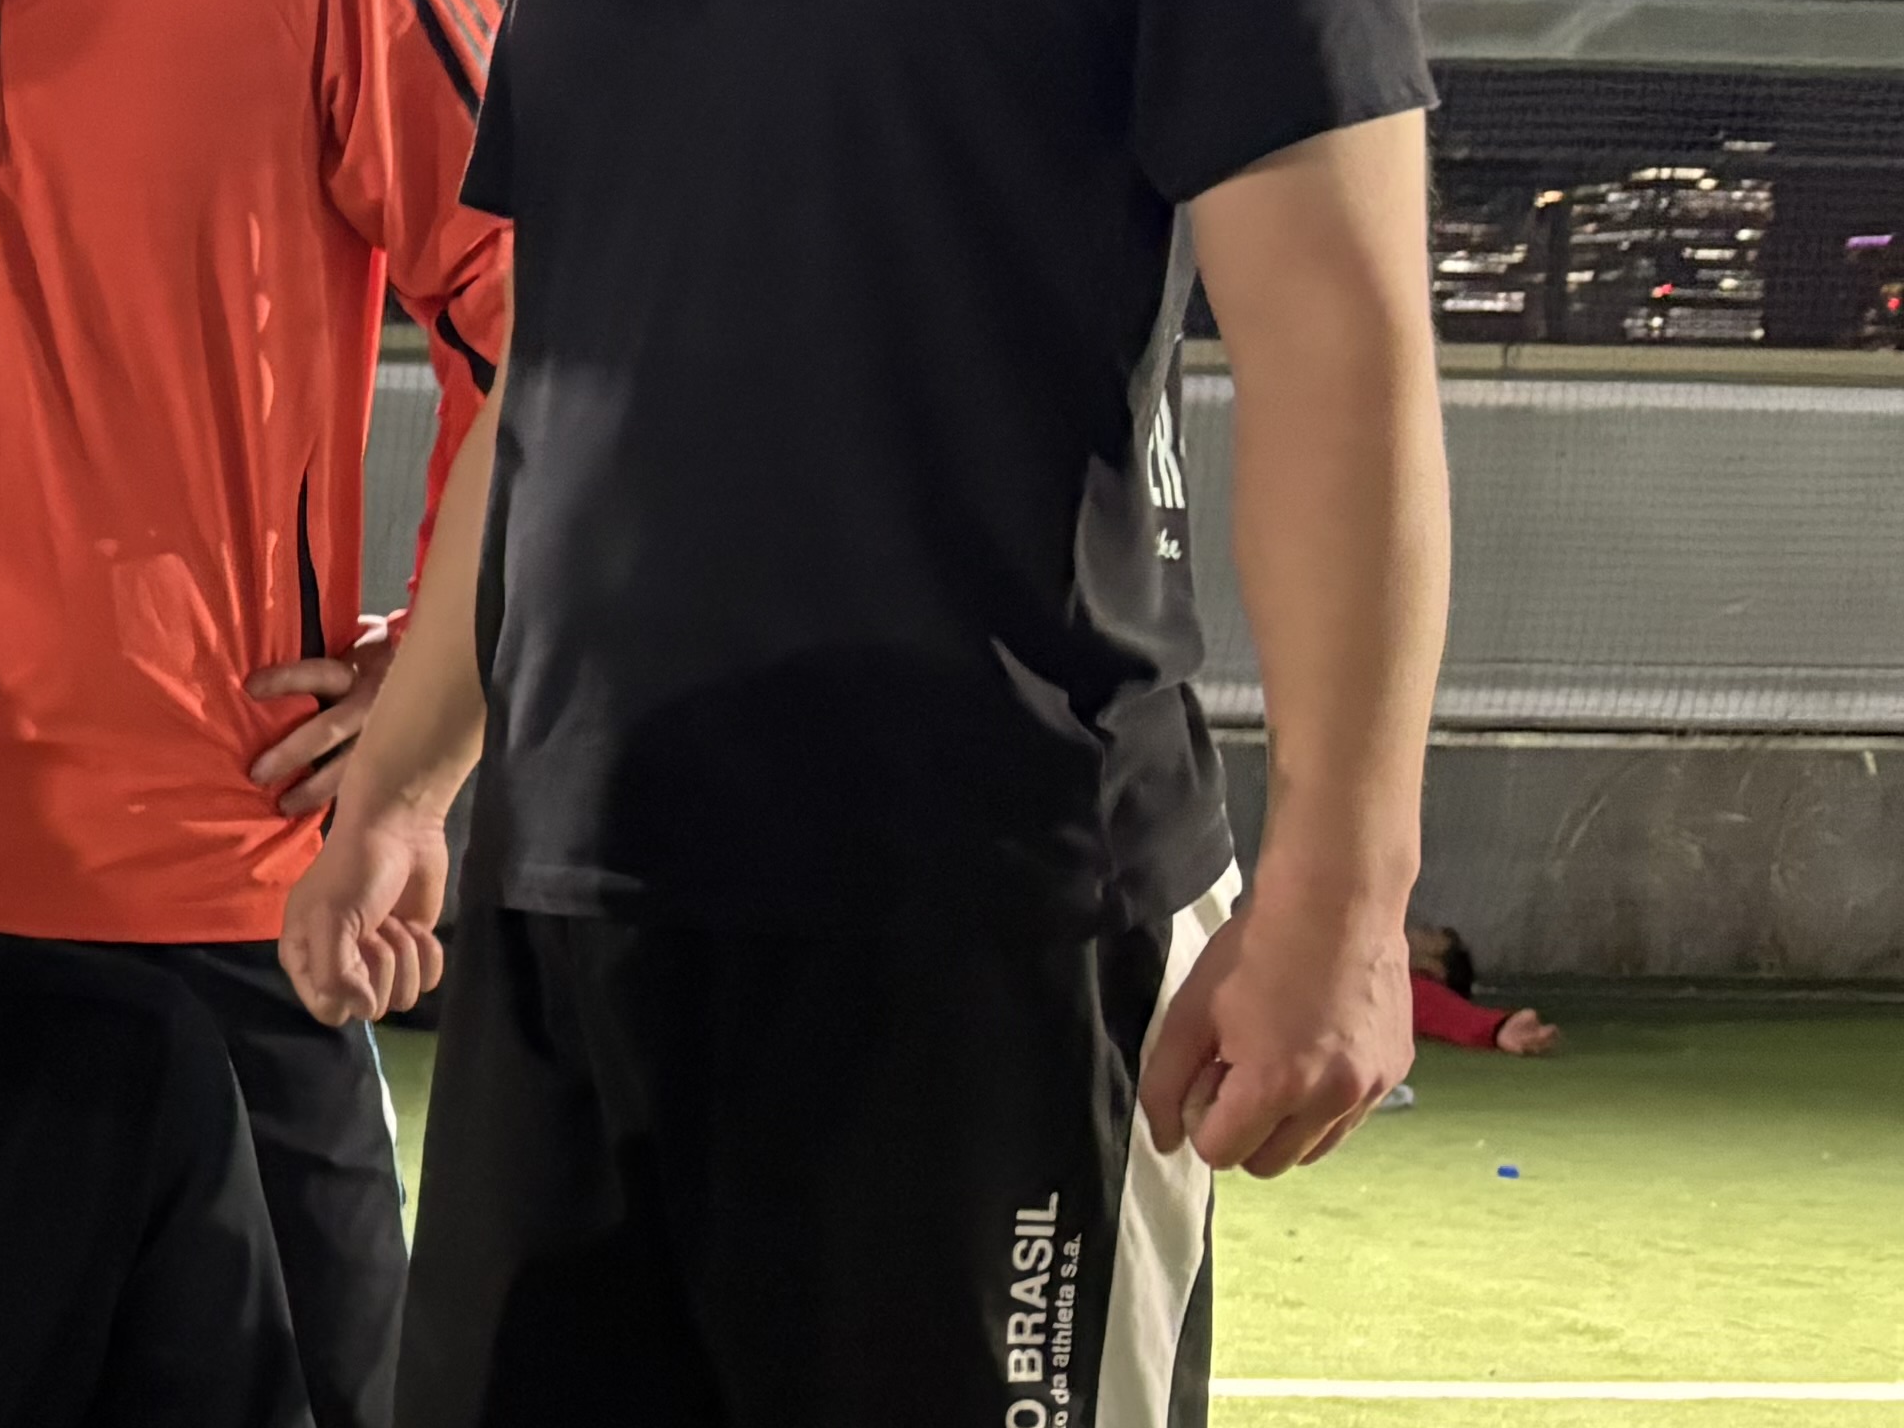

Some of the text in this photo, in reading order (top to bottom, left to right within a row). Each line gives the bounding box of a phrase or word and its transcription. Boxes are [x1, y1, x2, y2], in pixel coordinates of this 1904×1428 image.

[1005, 1191, 1060, 1384] BRASIL
[1051, 1284, 1076, 1368] athleta
[1049, 1372, 1071, 1405] da
